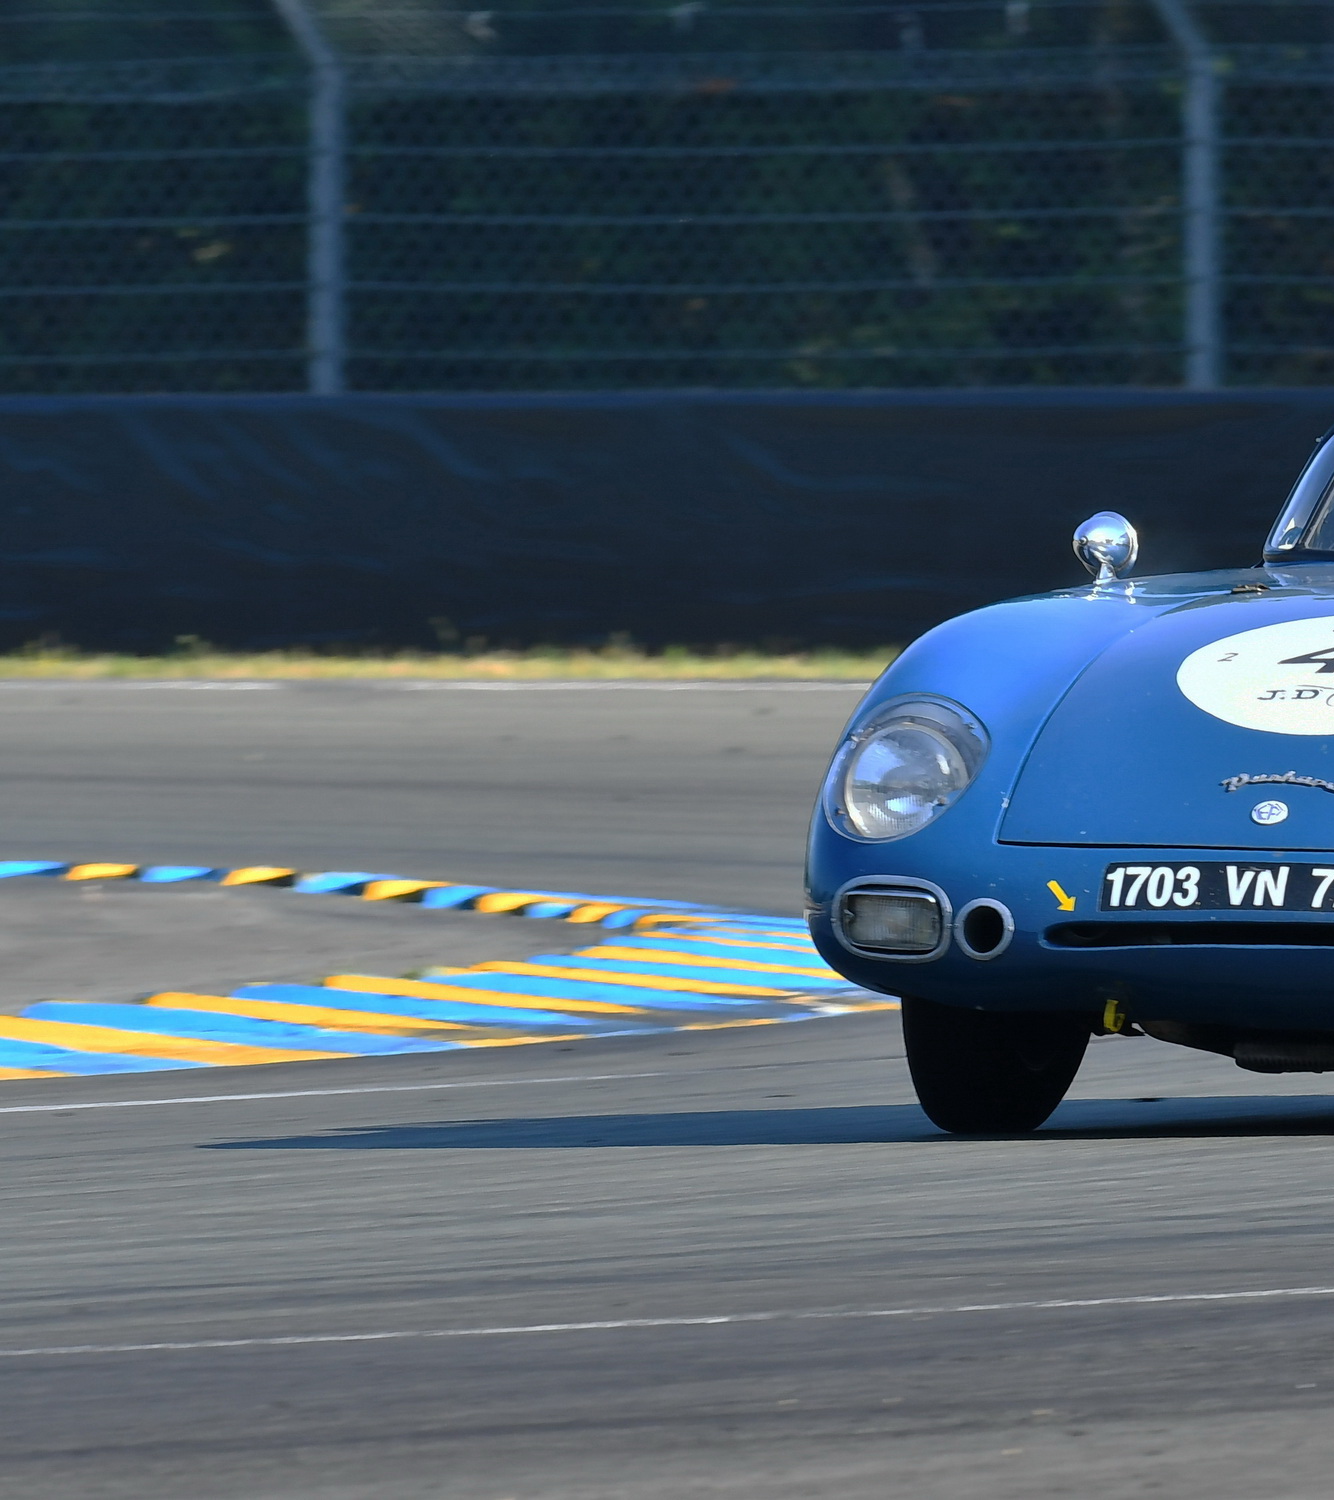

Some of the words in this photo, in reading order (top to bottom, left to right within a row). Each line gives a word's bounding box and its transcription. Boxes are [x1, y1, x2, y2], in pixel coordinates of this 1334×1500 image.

[1217, 651, 1239, 663] 2
[1106, 866, 1199, 907] 1703
[1225, 866, 1290, 907] VN
